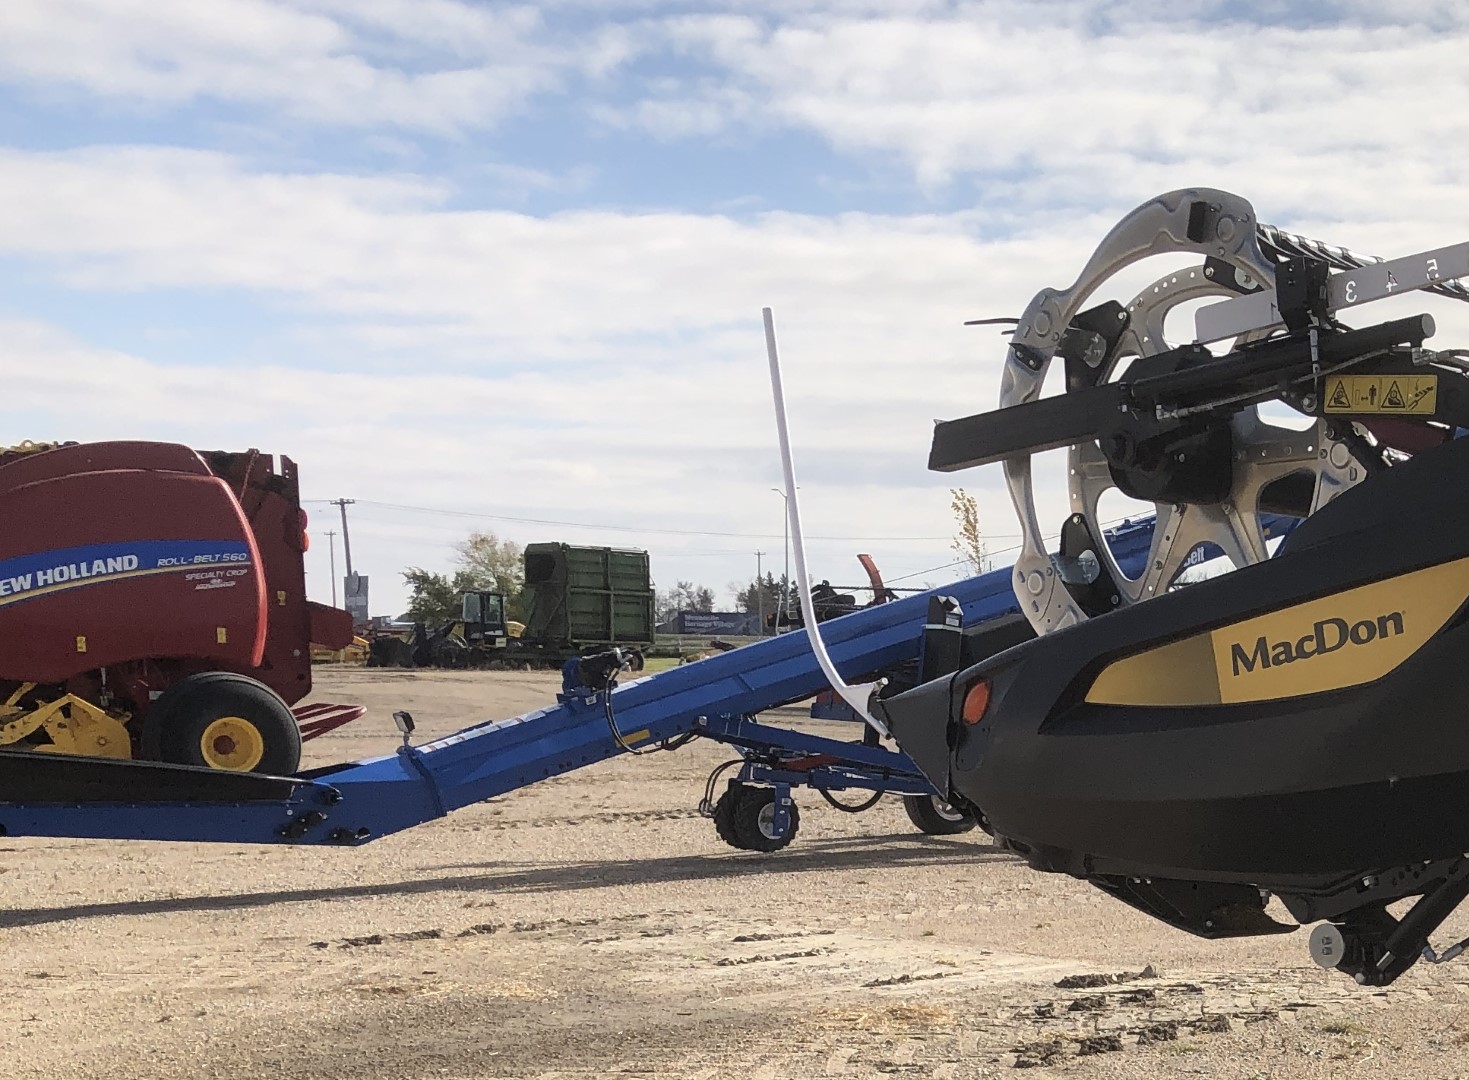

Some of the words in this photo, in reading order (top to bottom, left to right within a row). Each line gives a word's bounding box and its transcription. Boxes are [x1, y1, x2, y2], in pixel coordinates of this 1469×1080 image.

[157, 553, 220, 566] ROLL-BELT
[222, 552, 247, 561] 560
[0, 573, 32, 596] EW
[36, 554, 138, 586] HOLLAND
[185, 570, 224, 581] SPECIALTY
[226, 568, 248, 577] CROP
[1231, 611, 1403, 676] MacDon
